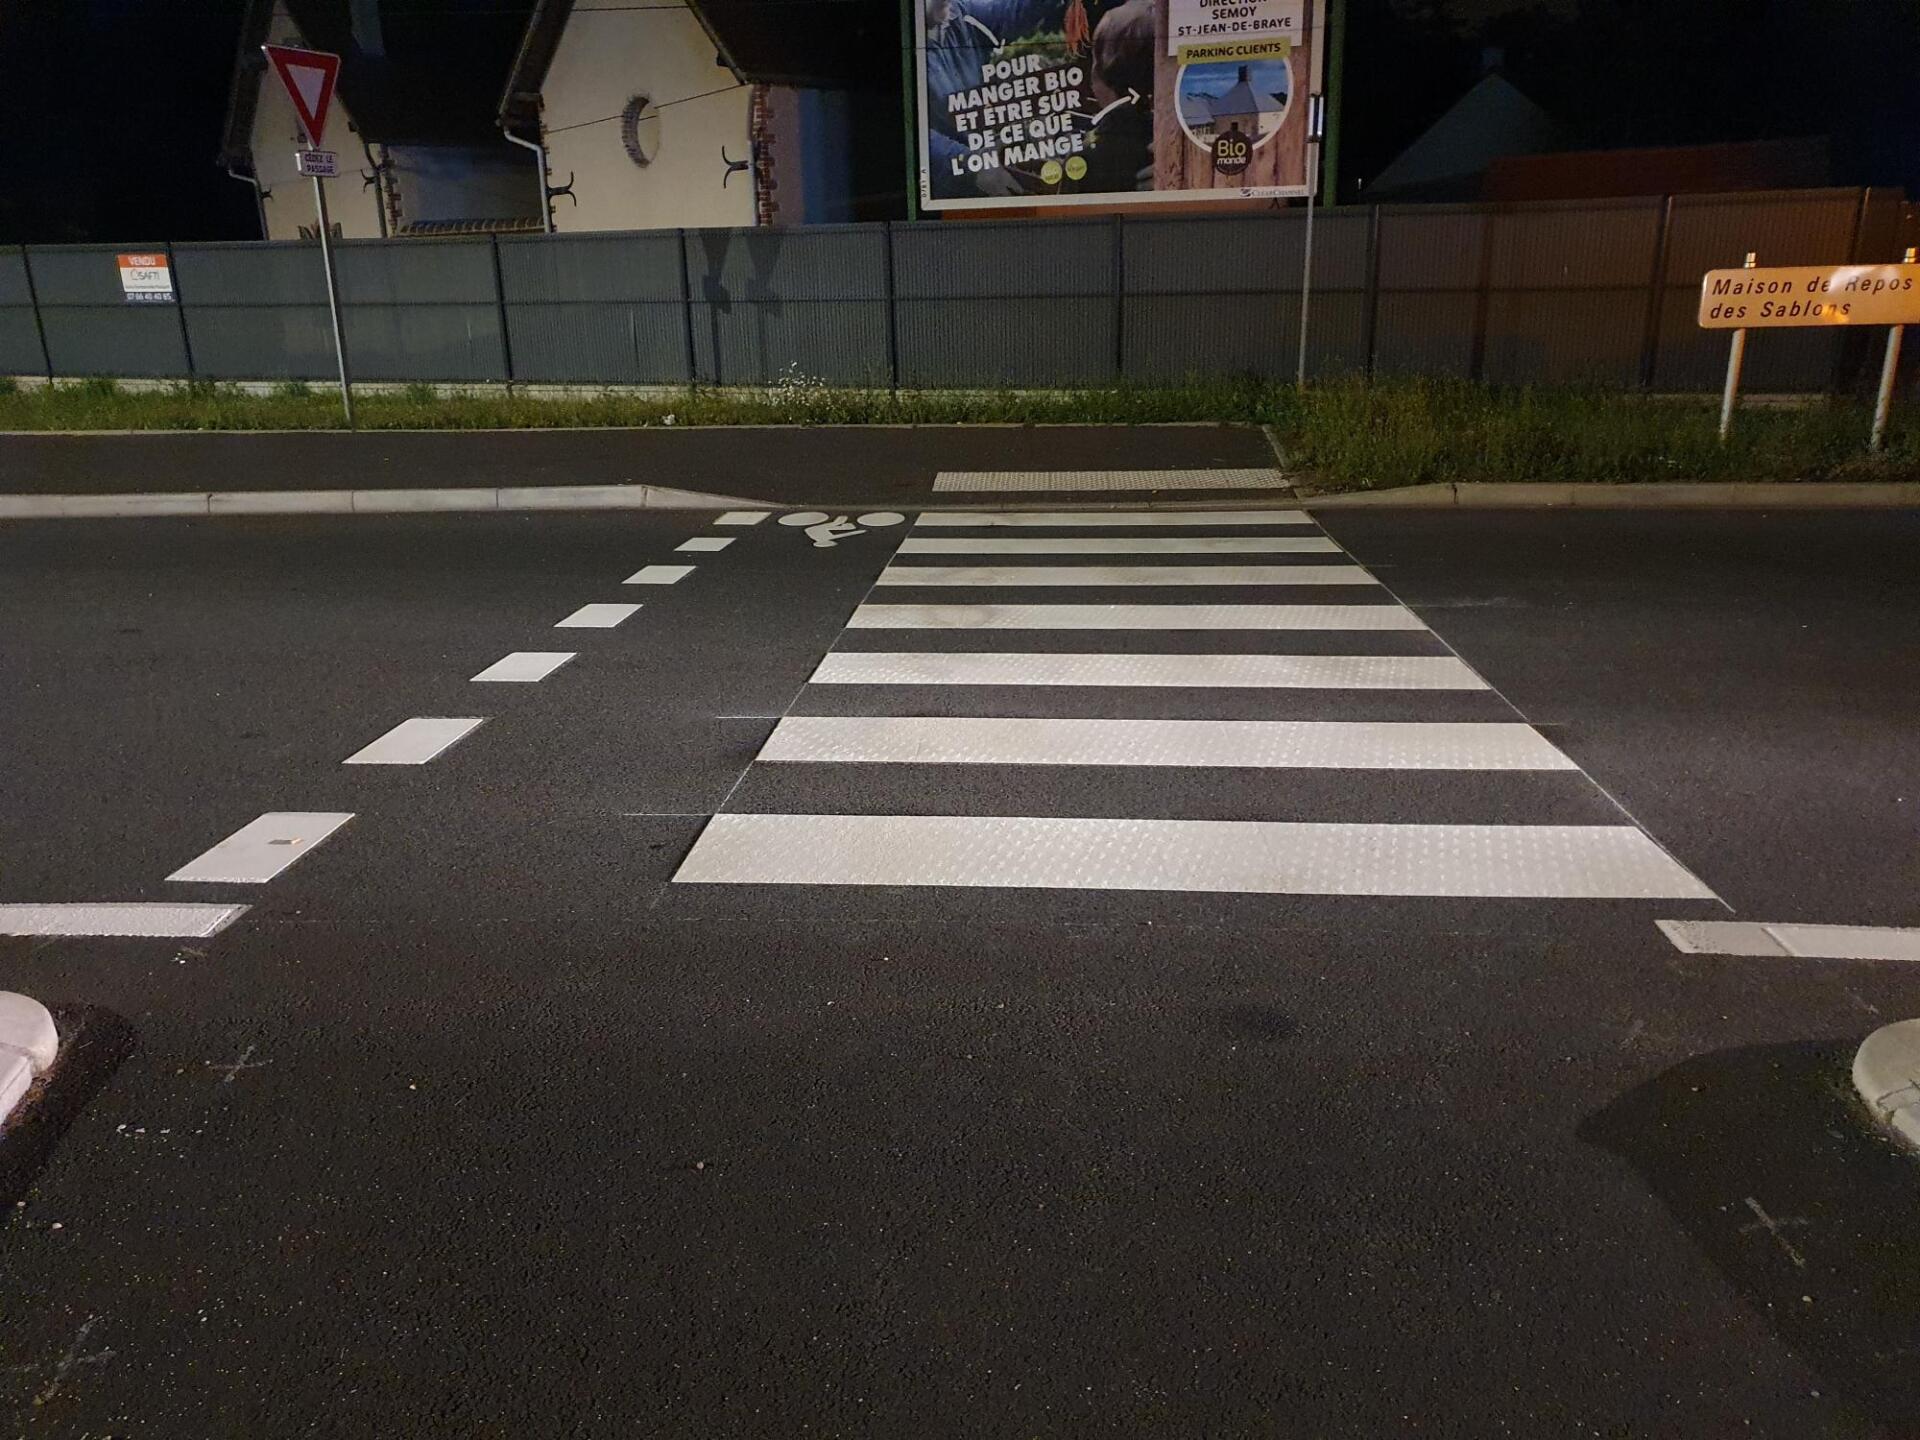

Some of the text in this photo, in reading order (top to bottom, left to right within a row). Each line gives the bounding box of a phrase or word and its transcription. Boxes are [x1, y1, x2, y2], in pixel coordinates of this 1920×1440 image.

[1212, 6, 1257, 20] SEMOY
[1178, 17, 1291, 36] ST-JEAN-DE-BRAYE
[1186, 42, 1281, 58] PARKING CLIENTS
[982, 54, 1042, 83] POUR
[948, 66, 1084, 113] MANGER BIO
[955, 111, 979, 132] ET
[1038, 88, 1082, 115] SÛR
[967, 113, 1073, 151] DE CE QUE
[951, 133, 1084, 176] L'ON MANGE
[1217, 138, 1247, 157] Bio
[1216, 156, 1247, 165] monde
[127, 255, 156, 266] VENDU
[1712, 276, 1914, 296] Maison de Repos
[1710, 300, 1851, 319] des Sablons
